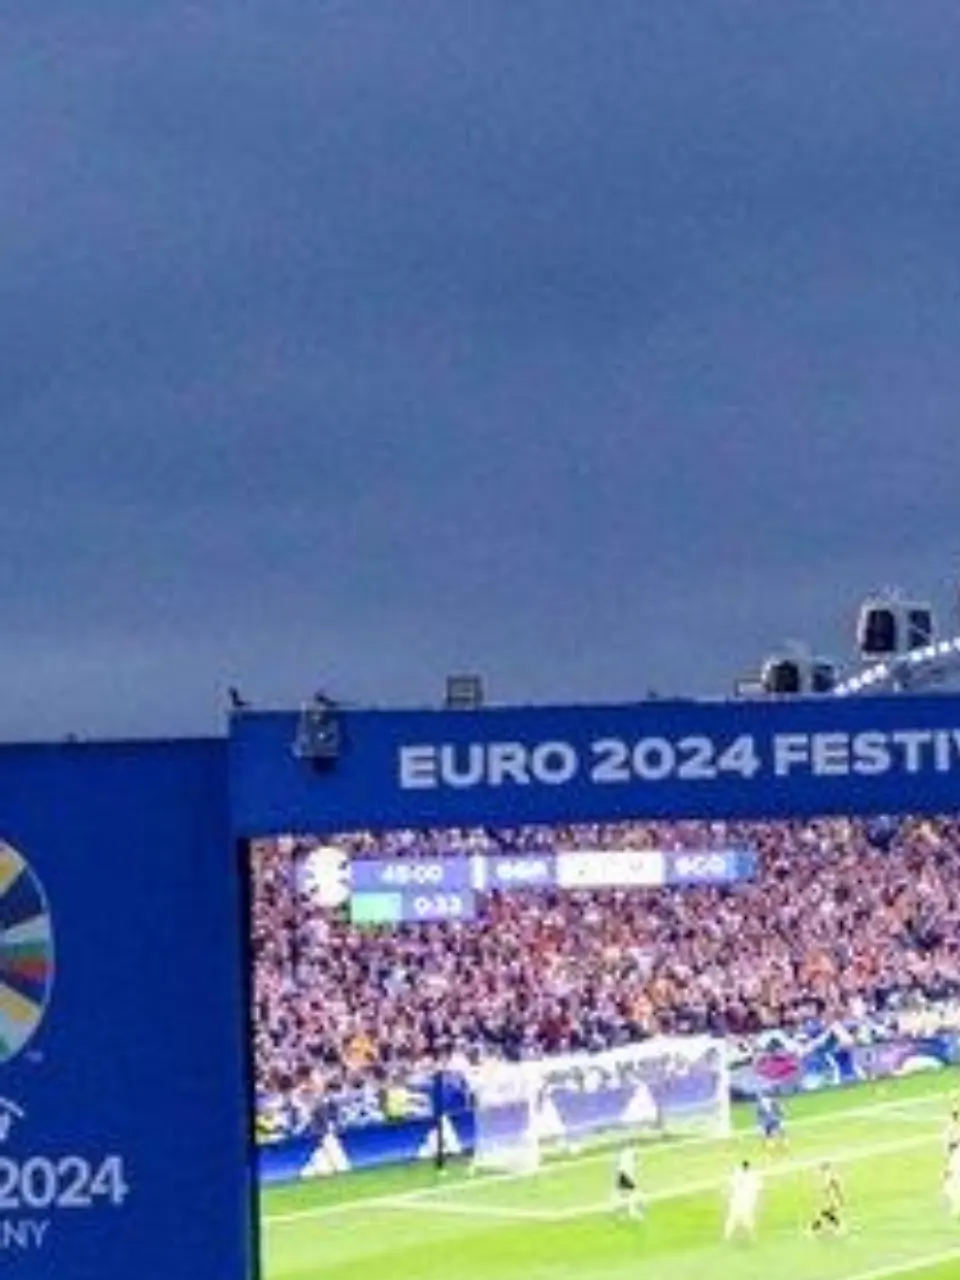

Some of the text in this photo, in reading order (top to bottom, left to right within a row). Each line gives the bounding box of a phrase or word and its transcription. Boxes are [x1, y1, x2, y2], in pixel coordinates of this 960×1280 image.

[400, 743, 576, 790] EURO
[592, 734, 758, 782] 2024
[0, 1218, 51, 1250] NY
